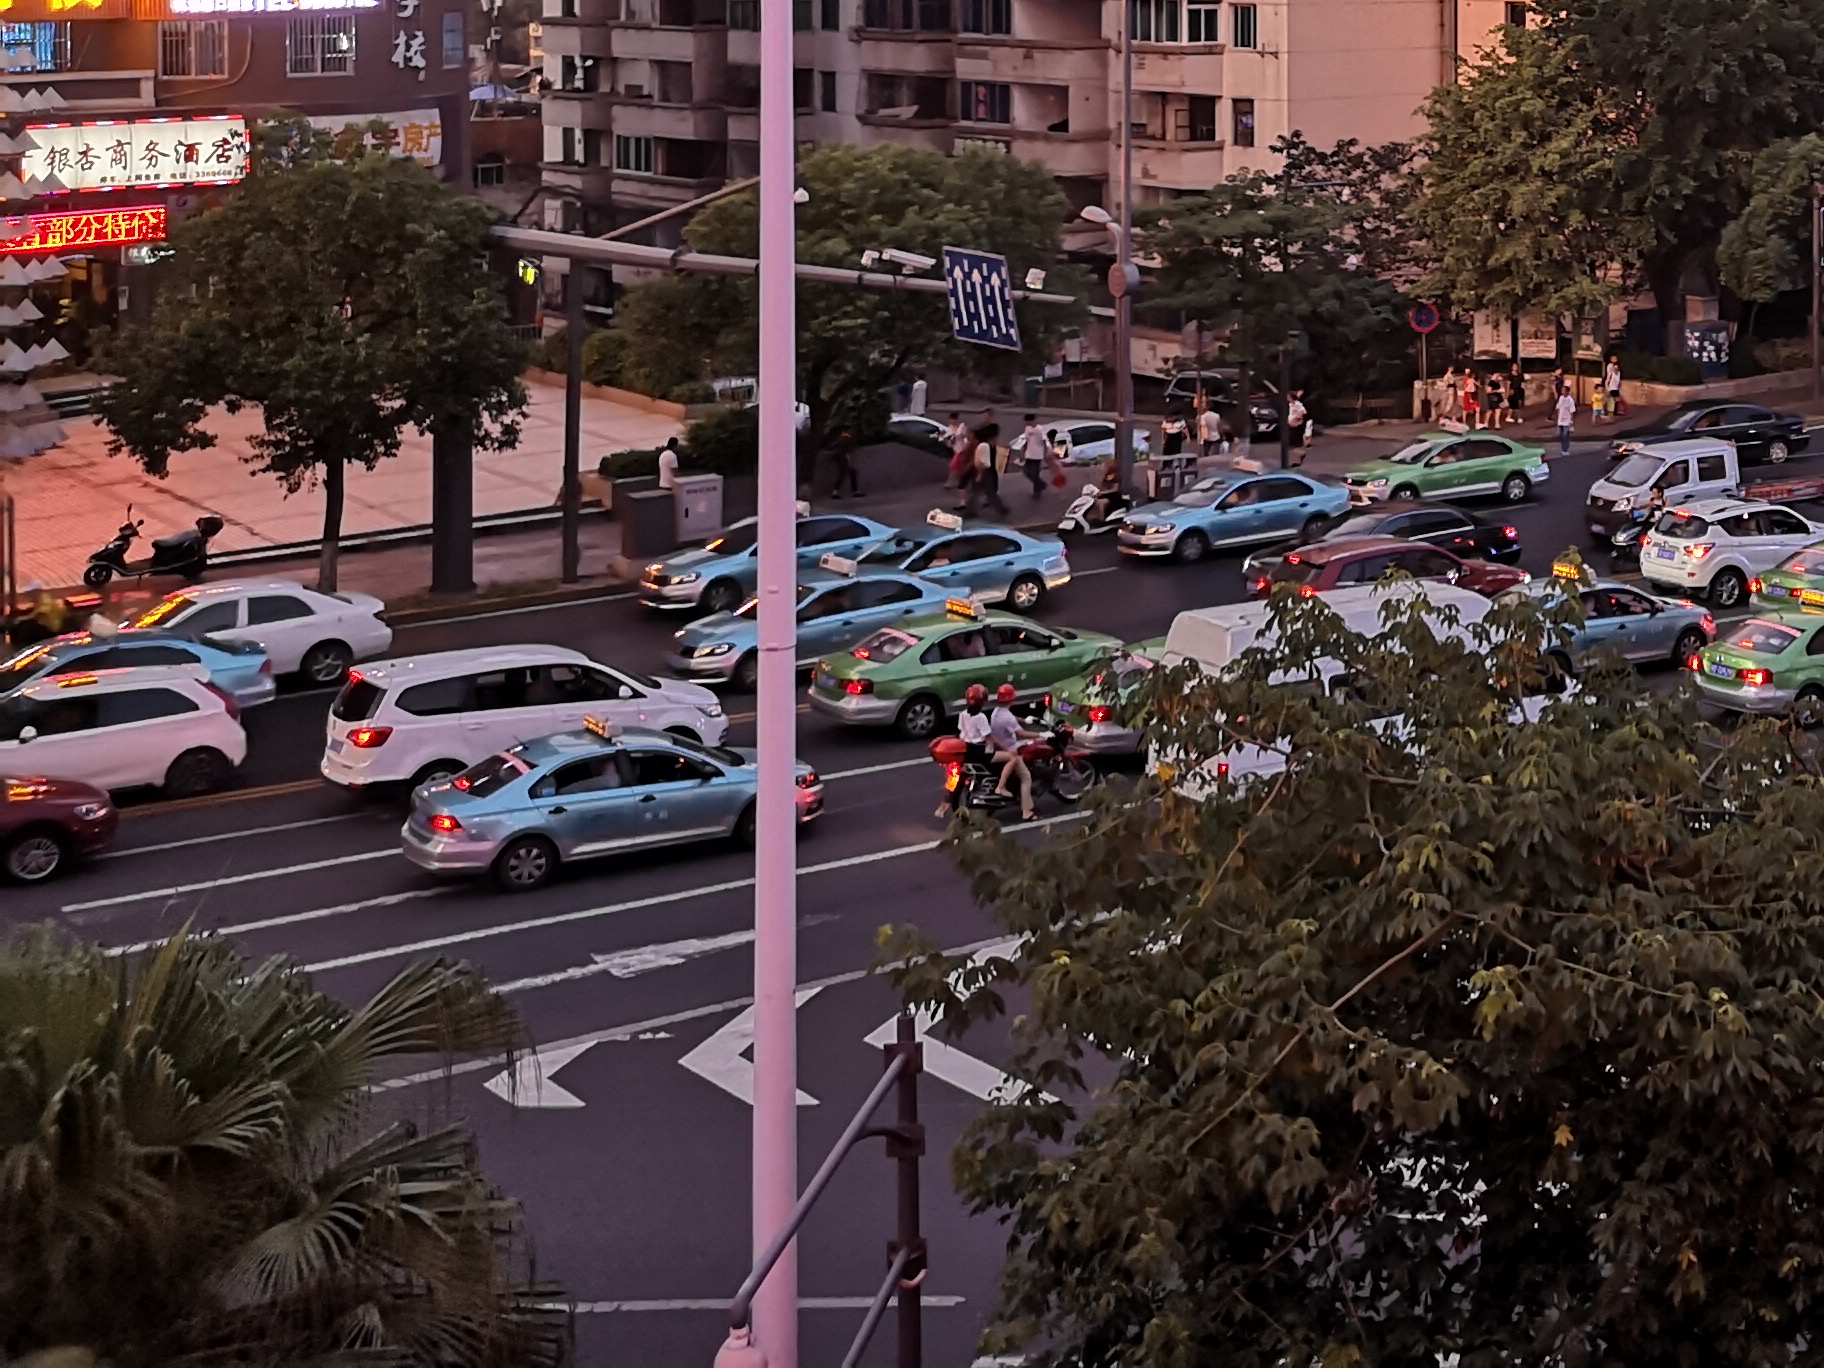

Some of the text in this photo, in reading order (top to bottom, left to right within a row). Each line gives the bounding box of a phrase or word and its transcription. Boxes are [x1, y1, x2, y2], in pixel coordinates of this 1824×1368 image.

[44, 138, 233, 173] 银杏商务酒店
